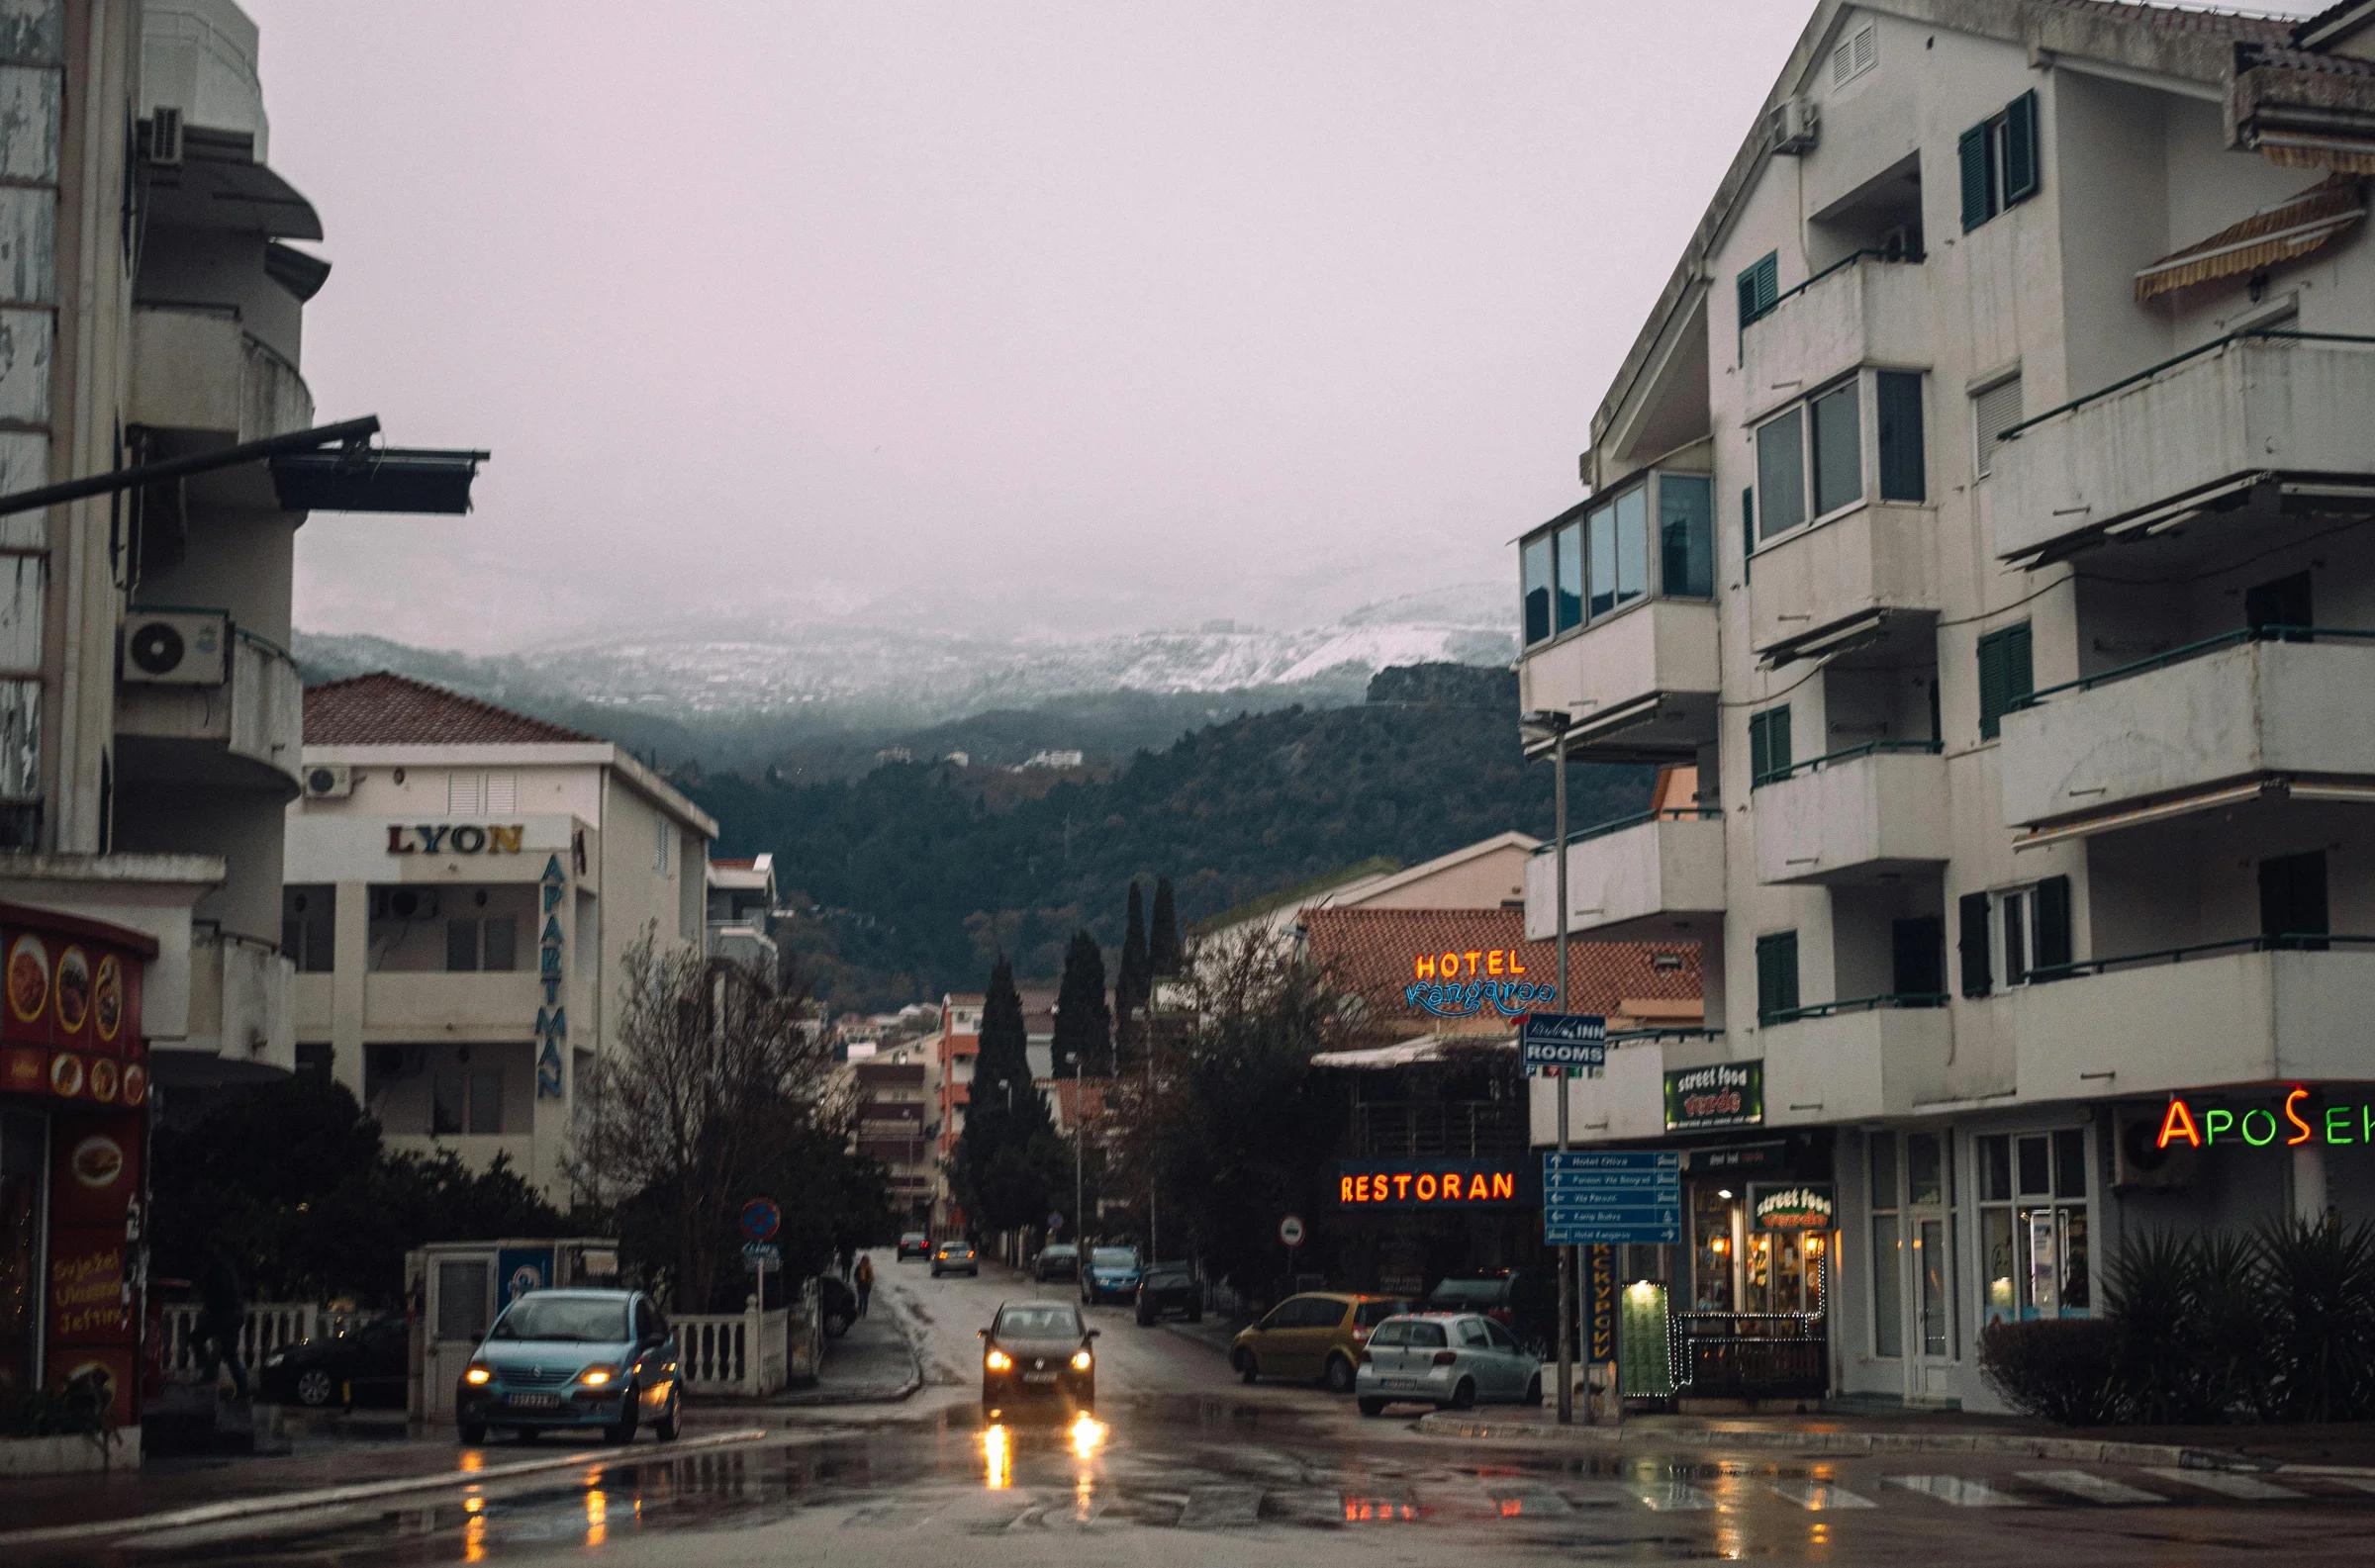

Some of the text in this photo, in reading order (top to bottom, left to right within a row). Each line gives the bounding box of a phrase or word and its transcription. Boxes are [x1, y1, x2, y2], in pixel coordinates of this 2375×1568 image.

[387, 824, 523, 854] LYON
[534, 853, 567, 1099] APARTMAN
[1415, 949, 1526, 979] HOTEL
[1406, 978, 1556, 1018] Kangaroo
[1527, 1044, 1603, 1062] ROOMS
[1678, 1064, 1747, 1093] street food
[1340, 1172, 1515, 1202] RESTORAN
[1757, 1186, 1799, 1217] street
